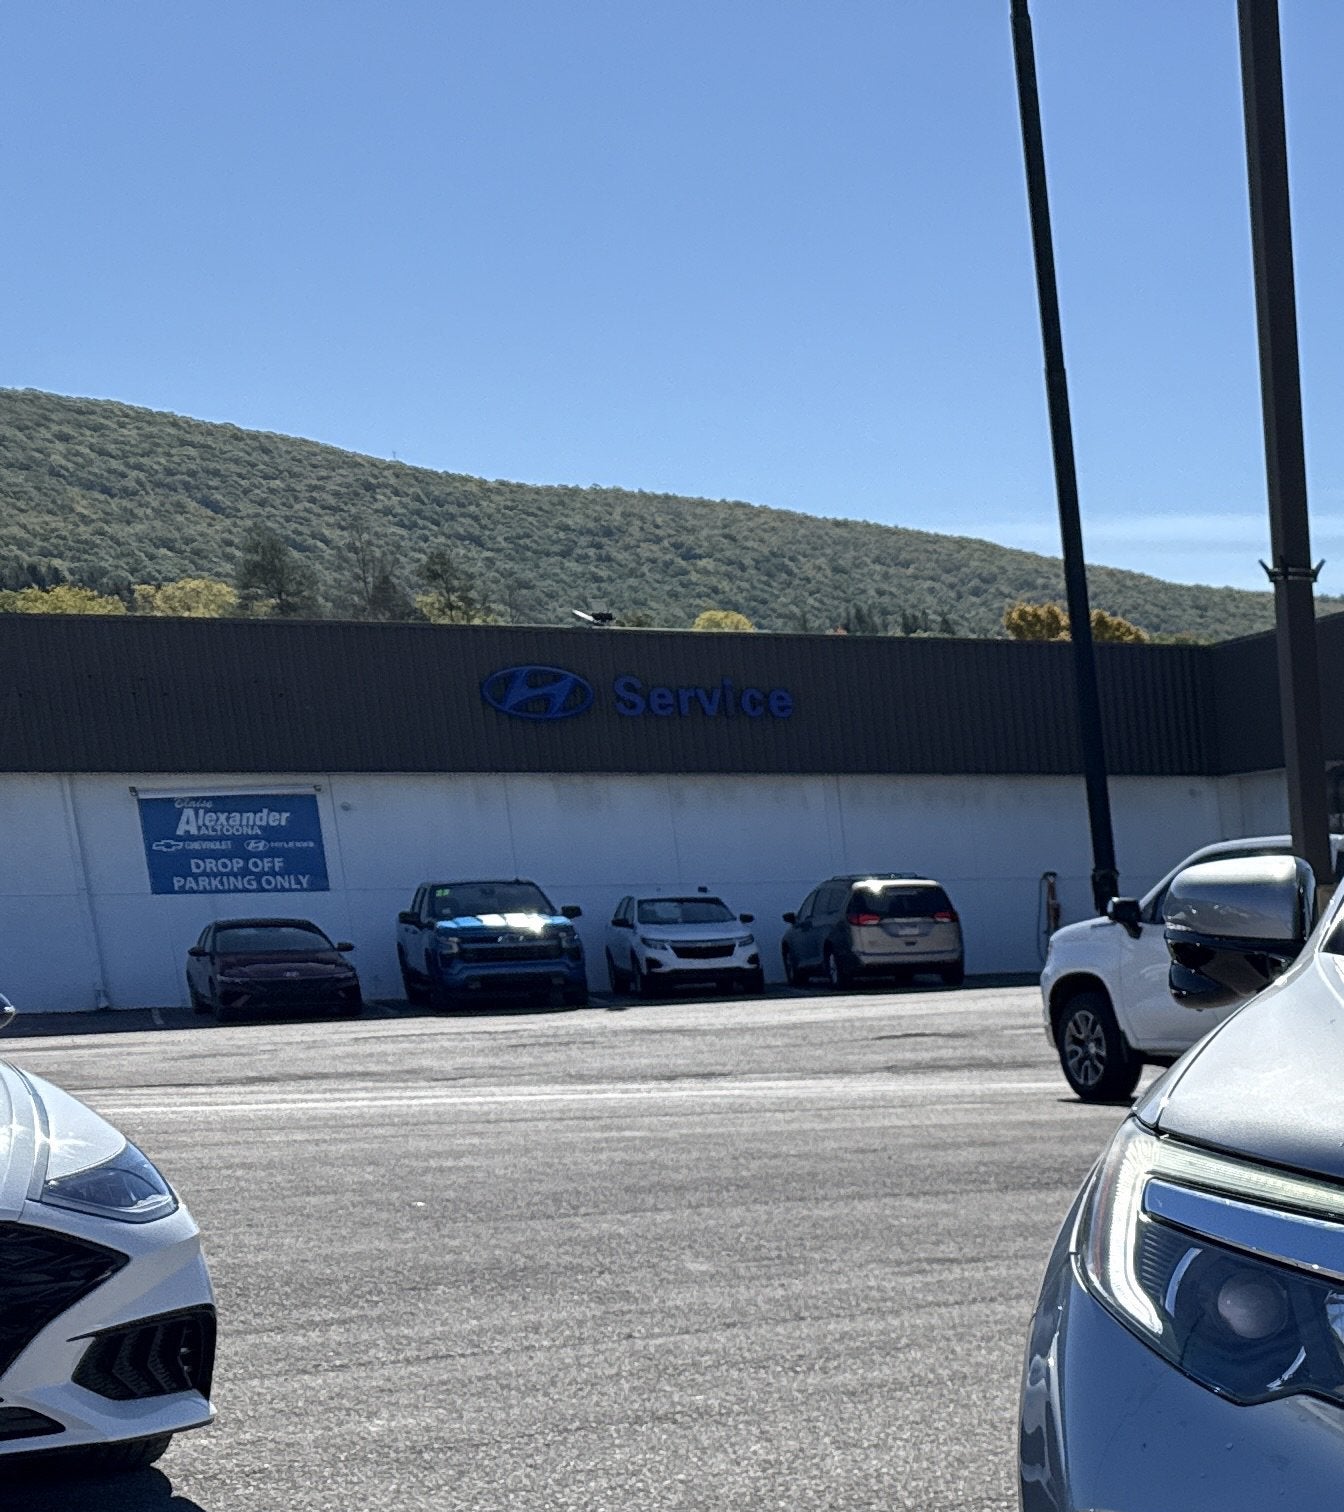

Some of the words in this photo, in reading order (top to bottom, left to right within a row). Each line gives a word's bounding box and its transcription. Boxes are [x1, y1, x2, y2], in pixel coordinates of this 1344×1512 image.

[613, 673, 794, 719] Service
[175, 808, 291, 835] Alexander
[200, 824, 262, 835] ALTOONA
[190, 858, 244, 873] DROP
[248, 857, 284, 873] OFF
[173, 875, 258, 891] PARKING
[261, 874, 311, 889] ONLY
